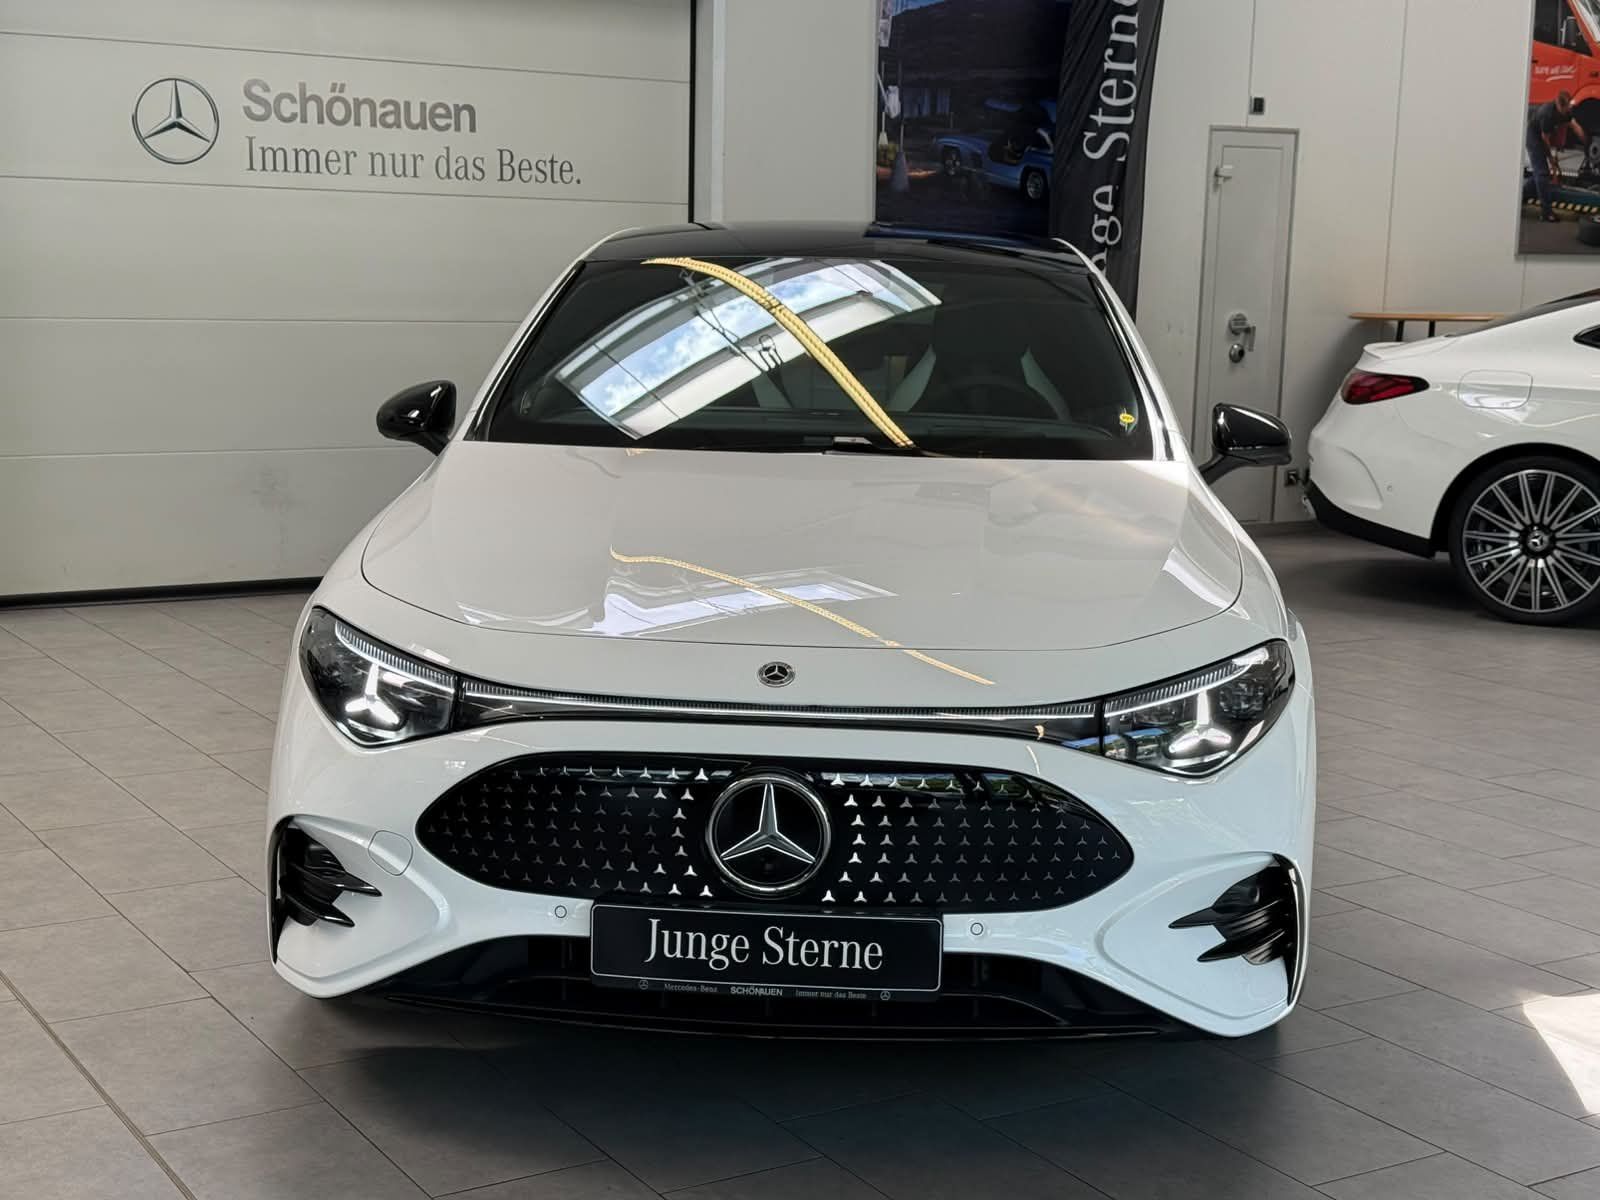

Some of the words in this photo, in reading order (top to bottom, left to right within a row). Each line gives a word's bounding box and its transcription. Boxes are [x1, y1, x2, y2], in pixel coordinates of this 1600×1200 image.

[242, 78, 477, 133] Schönauen
[244, 135, 358, 176] Immer
[368, 150, 425, 179] nur
[434, 146, 486, 182] das
[496, 148, 582, 185] Beste.
[644, 918, 750, 971] Junge
[761, 926, 884, 970] Sterne
